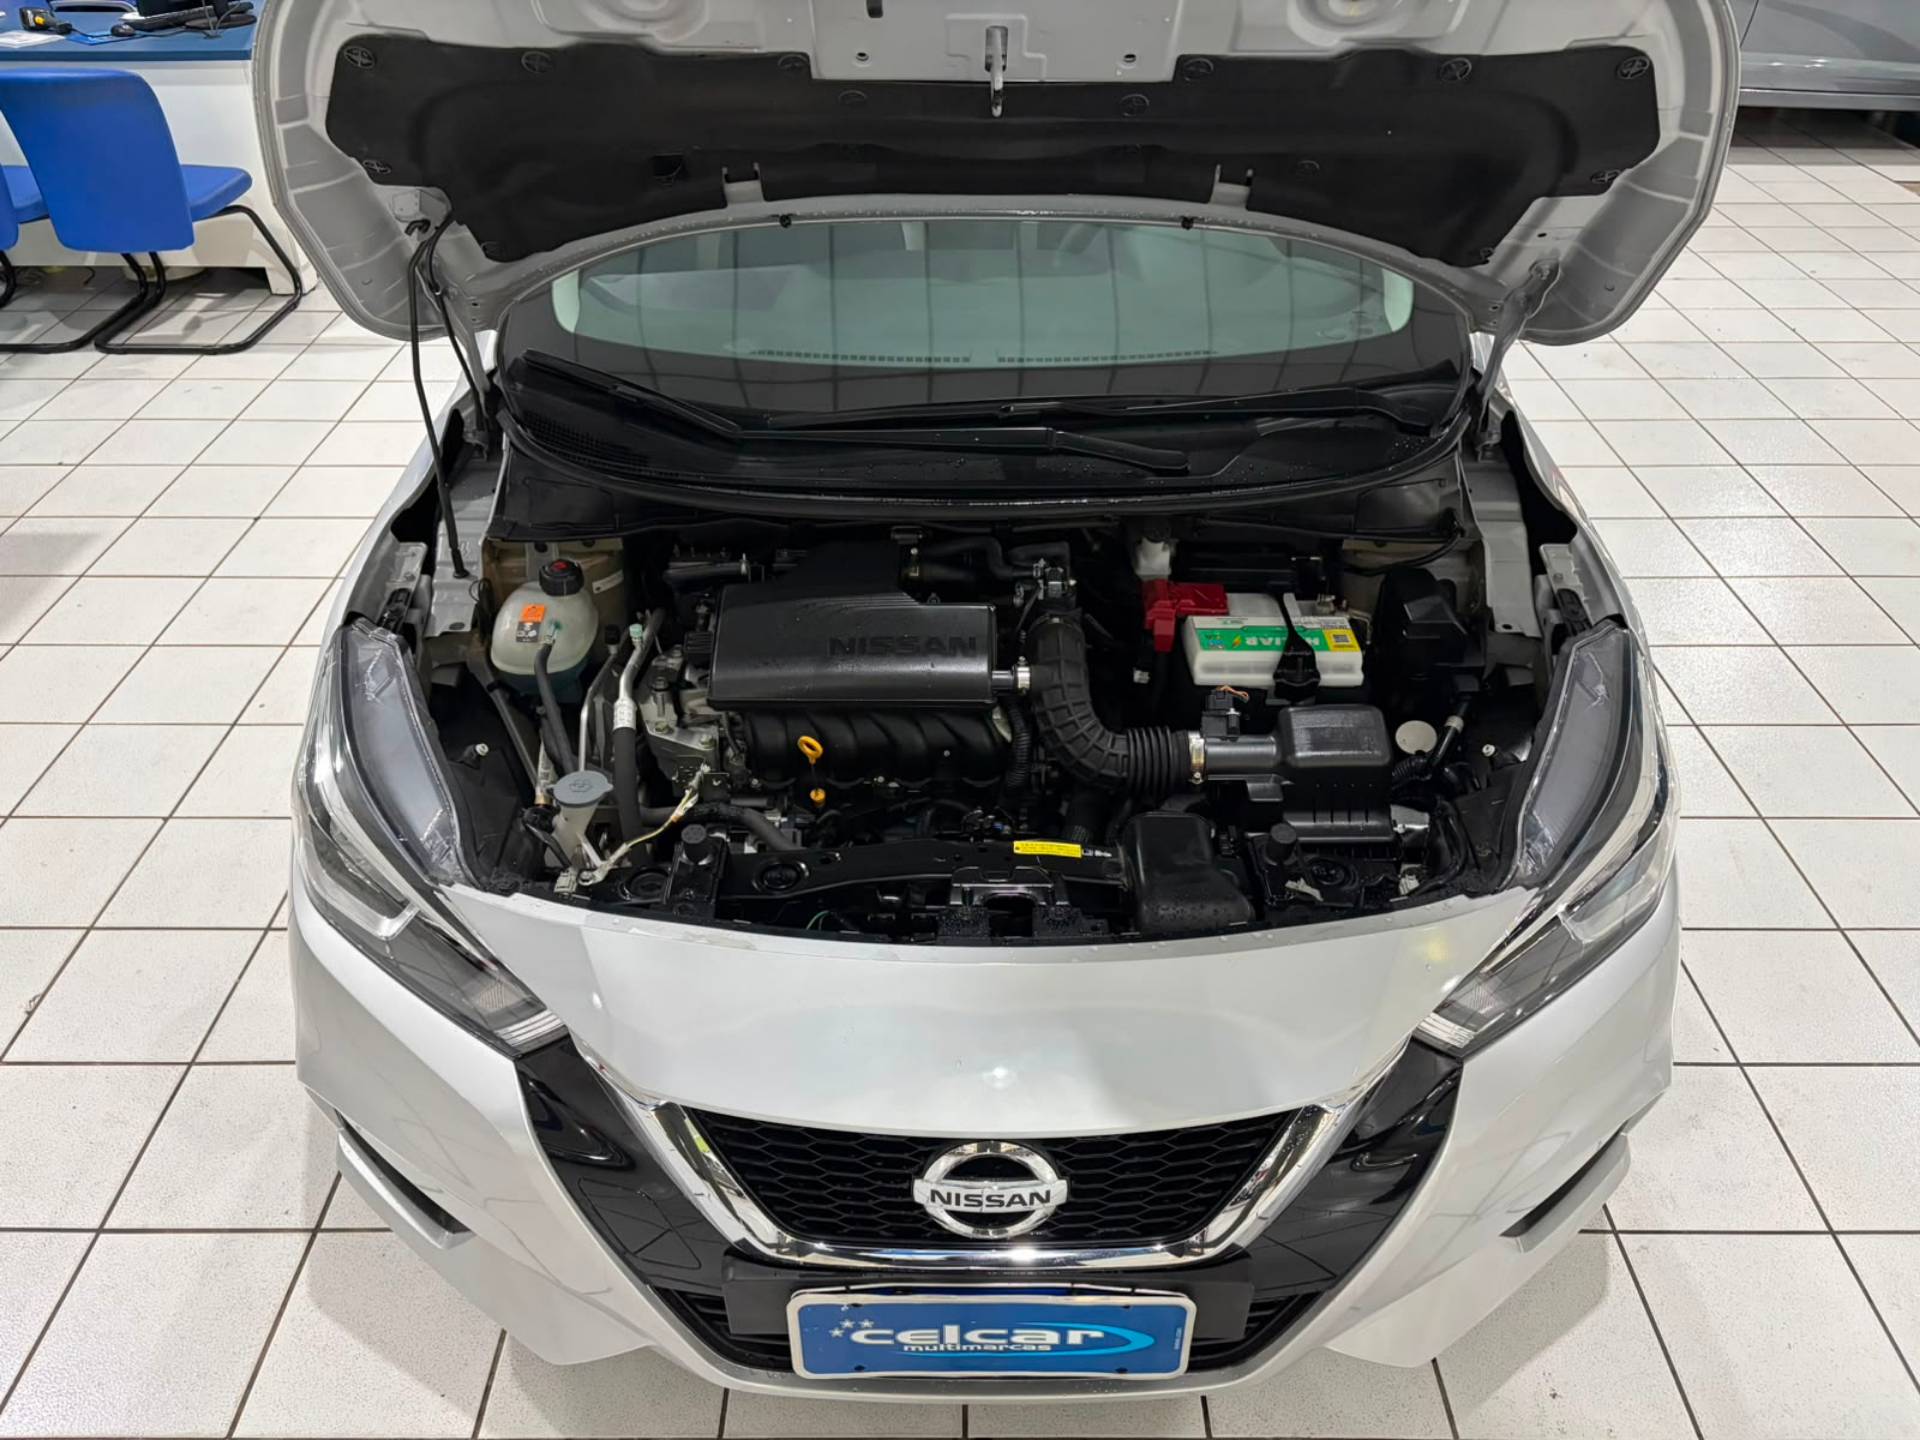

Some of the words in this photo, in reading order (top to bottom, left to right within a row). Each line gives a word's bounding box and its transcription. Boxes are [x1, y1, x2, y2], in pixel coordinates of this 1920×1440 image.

[829, 635, 977, 657] NISSAN
[1245, 636, 1320, 647] HIAR
[930, 1189, 1051, 1208] NISSAN
[850, 1324, 1104, 1345] celcar
[903, 1342, 1052, 1352] multimarcas
